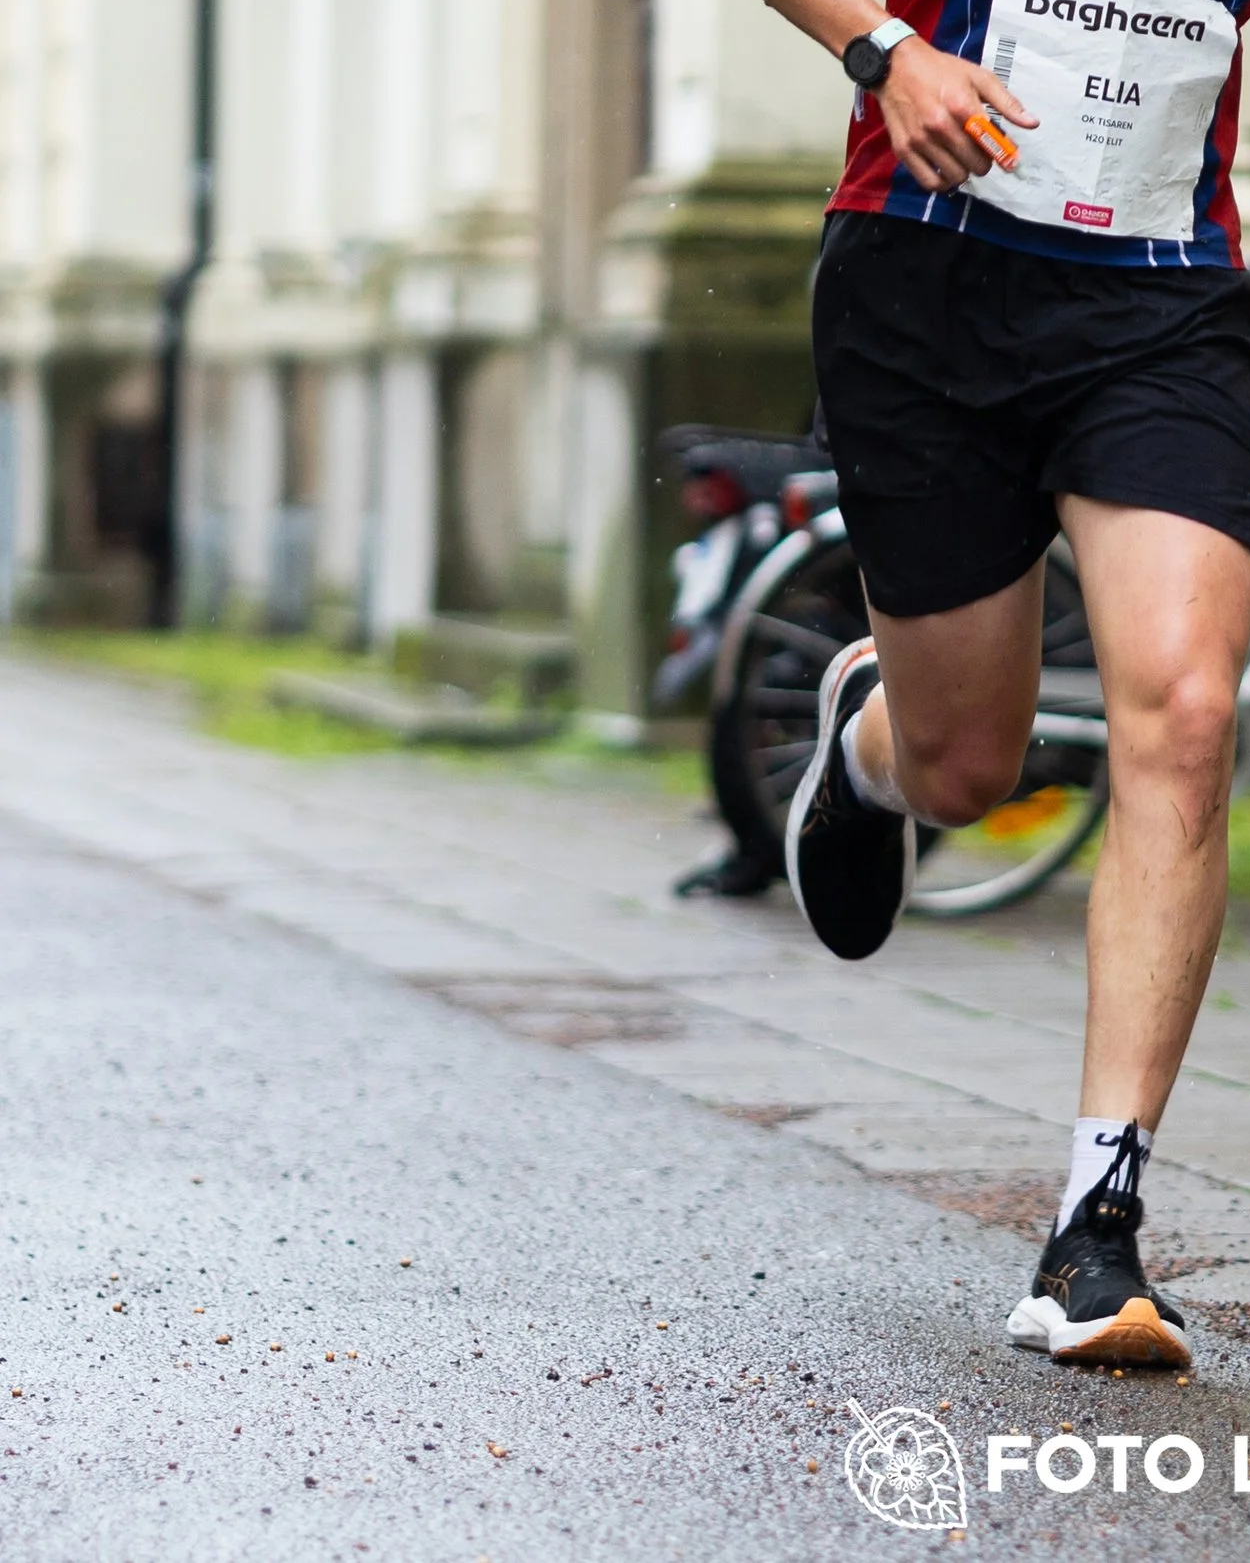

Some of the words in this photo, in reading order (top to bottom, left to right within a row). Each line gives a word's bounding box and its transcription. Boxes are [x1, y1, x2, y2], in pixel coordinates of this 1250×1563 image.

[1083, 73, 1142, 107] ELIA
[1081, 113, 1096, 125] OK
[1098, 116, 1134, 131] TISAREN
[1106, 135, 1124, 147] ELIT
